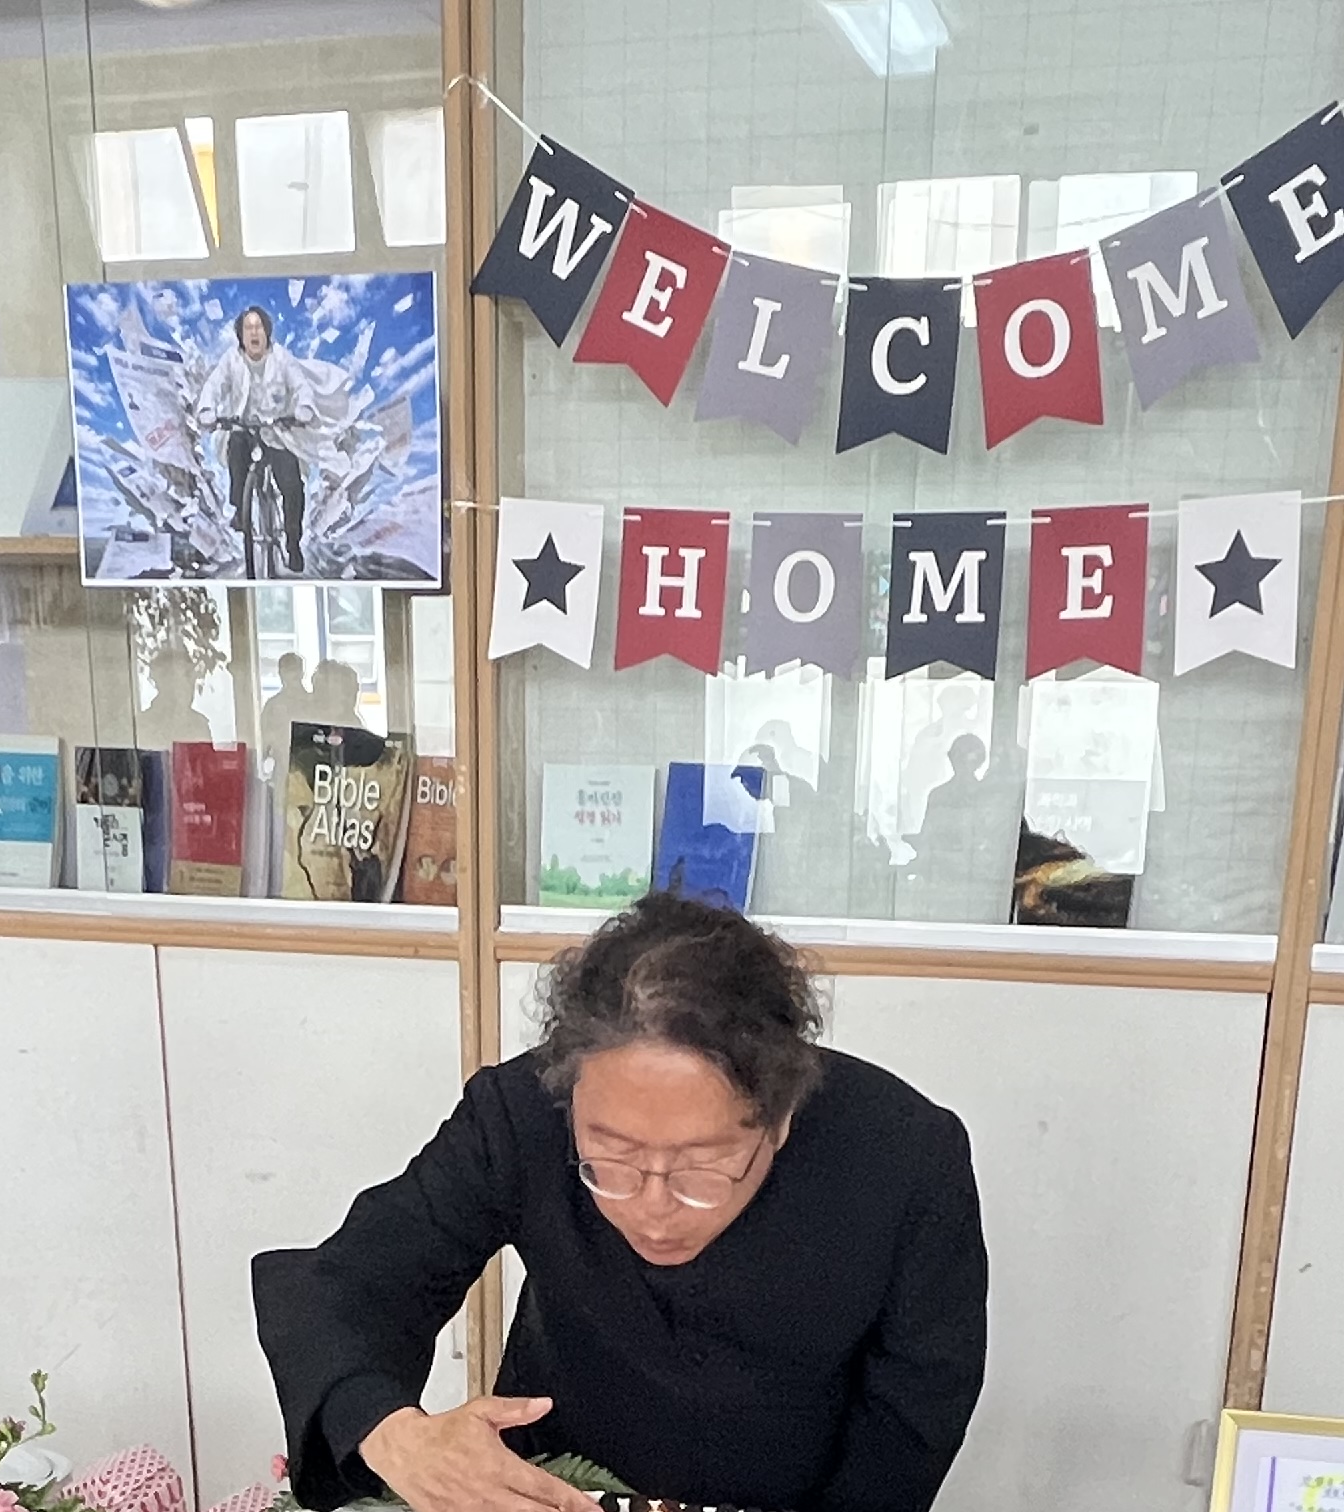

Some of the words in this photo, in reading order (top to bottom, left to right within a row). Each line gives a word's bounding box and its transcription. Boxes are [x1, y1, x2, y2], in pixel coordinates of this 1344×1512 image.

[639, 542, 1116, 626] HOME
[312, 763, 381, 812] Bible
[309, 805, 375, 851] Atlas
